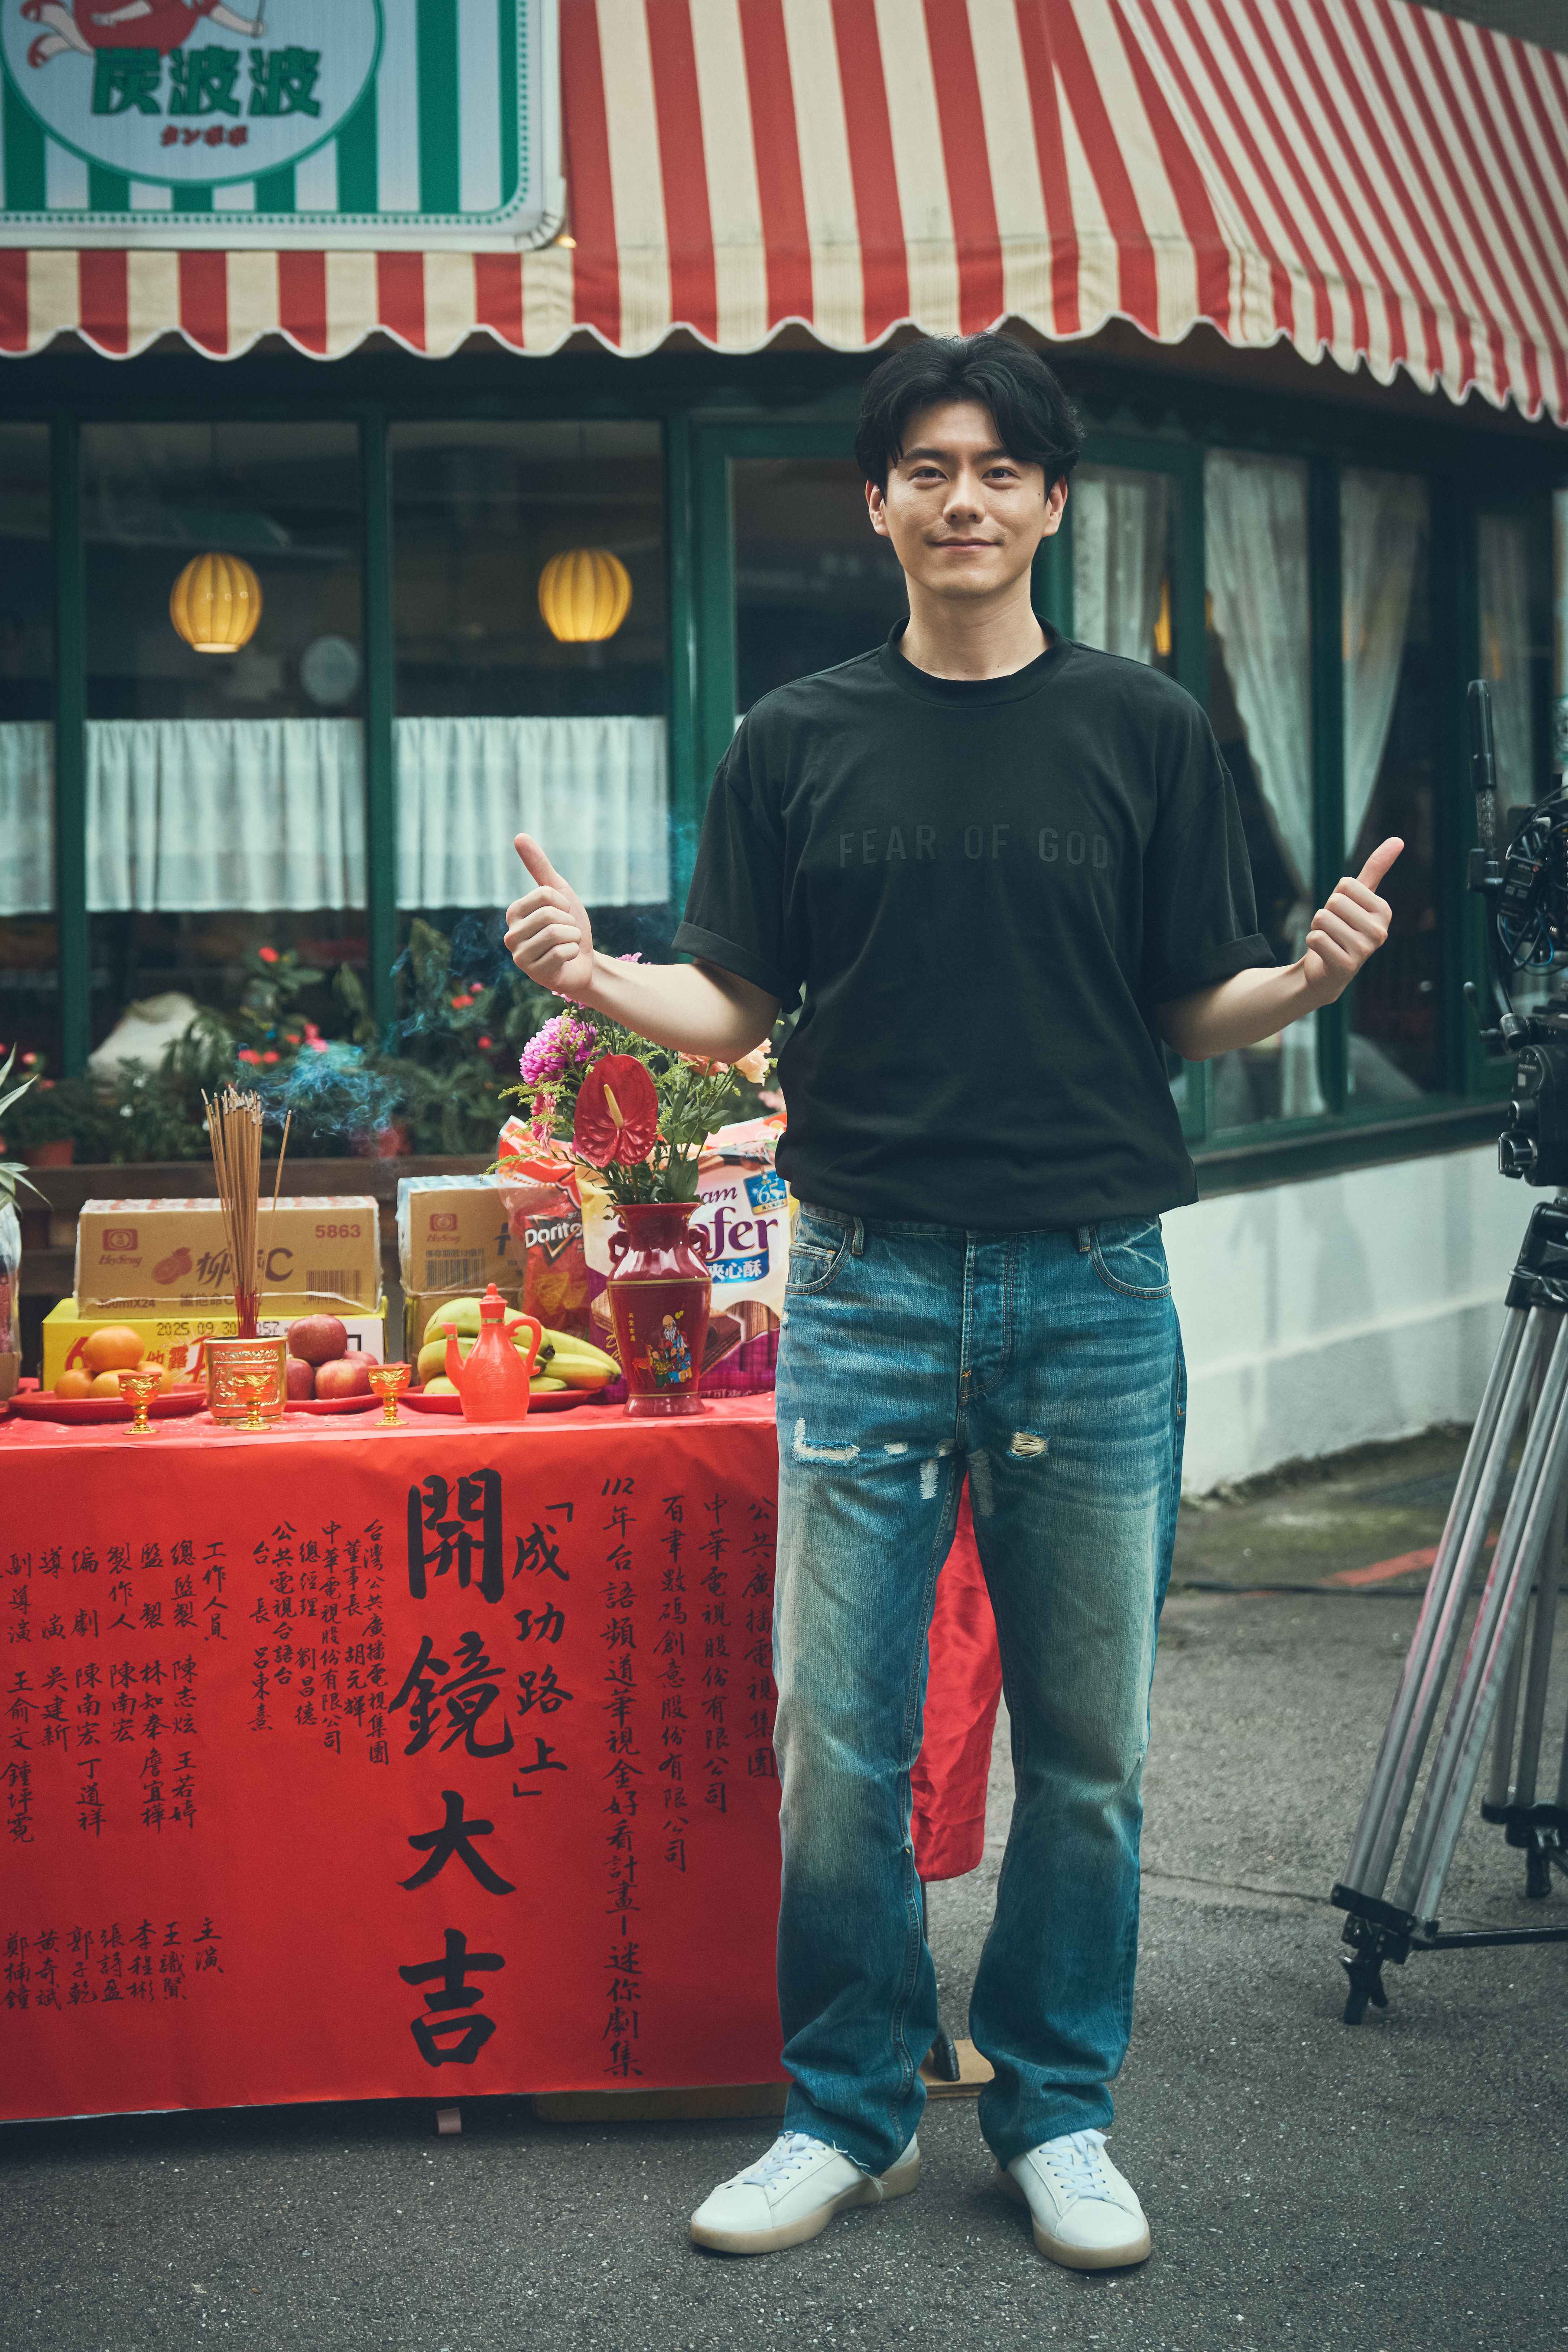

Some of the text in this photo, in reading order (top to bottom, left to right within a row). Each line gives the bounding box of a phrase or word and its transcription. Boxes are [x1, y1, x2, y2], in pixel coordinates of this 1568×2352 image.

[839, 824, 1108, 869] FEAR OF GOD
[315, 1224, 360, 1238] 5863
[525, 1222, 583, 1248] Dorito
[157, 1322, 189, 1336] 2025
[198, 1322, 213, 1335] 09
[6, 1553, 31, 1643] 副導演
[139, 1543, 164, 1629] 監製
[170, 1540, 198, 1627] 總監製
[202, 1542, 228, 1641] 工作人員
[249, 1540, 272, 1624] 台長
[269, 1521, 297, 1685] 公共電視台語台
[37, 1546, 70, 1752] 導演 吳建新
[107, 1543, 138, 1742] 製作人 陳南宏
[294, 1540, 322, 1725] 總經理 劉昌德
[319, 1521, 342, 1755] 中華電視股份有限公司
[342, 1539, 369, 1728] 董事長 胡元輝
[699, 1493, 731, 1814] 中華電視股份有限公司
[72, 1546, 107, 1837] 編劇 陳南宏 丁道祥
[387, 1467, 517, 2068] 開鏡大吉
[67, 1926, 98, 2005] 郭子乾
[95, 1923, 125, 2002] 張詩盈
[159, 1921, 186, 2000] 王識賢
[193, 1917, 224, 1973] 主演
